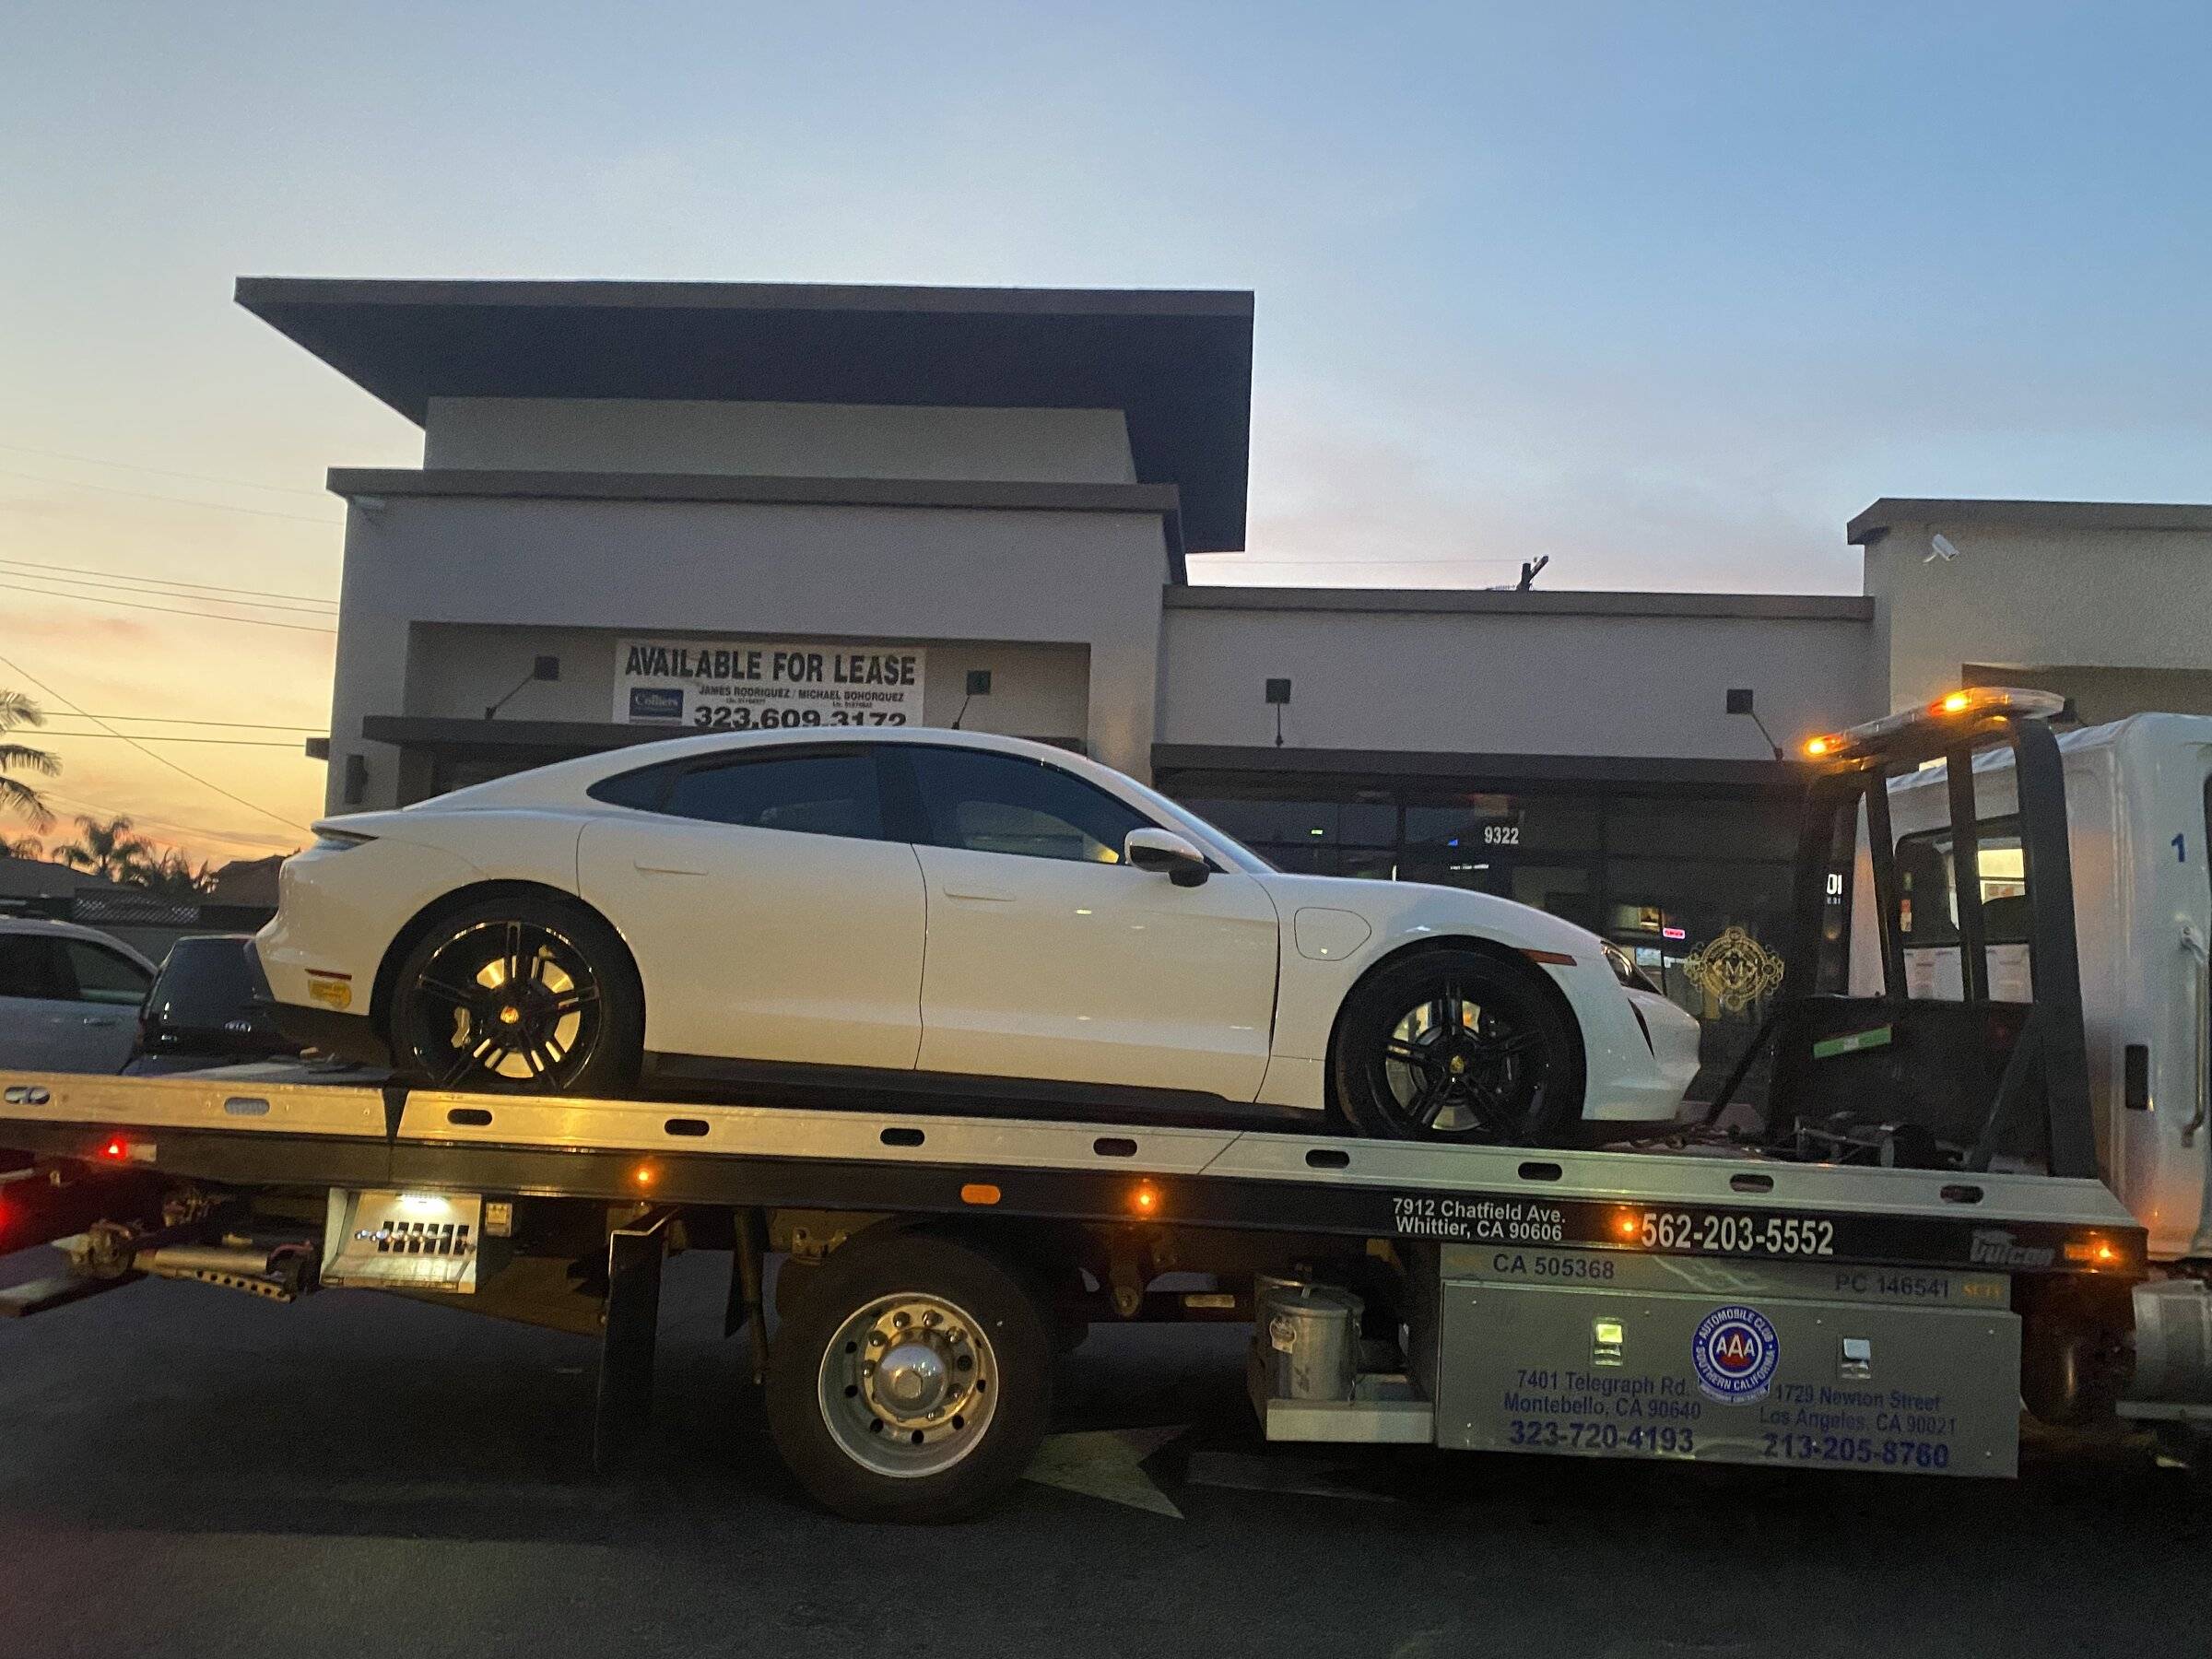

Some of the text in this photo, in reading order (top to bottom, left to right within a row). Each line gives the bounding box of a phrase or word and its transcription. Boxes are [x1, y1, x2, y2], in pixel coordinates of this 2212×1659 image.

[625, 646, 915, 686] AVAILABLE FOR LEASE
[699, 685, 731, 697] JAMES
[734, 687, 790, 700] RODRIGUEZ
[798, 689, 841, 701] MICHAEL
[1484, 826, 1520, 845] 9322
[2171, 833, 2185, 863] 1
[1393, 1197, 1566, 1224] 7912 Chatfield Ave.
[1395, 1216, 1563, 1241] Whittier, CA 90606
[1641, 1212, 1834, 1255] 562-203-5552
[1493, 1253, 1614, 1280] CA 505368
[1834, 1273, 1866, 1294] PC
[1877, 1277, 1948, 1298] 146541
[1699, 1309, 1774, 1343] AUTOMOBILE CLUB
[1716, 1334, 1756, 1359] AAA
[1696, 1347, 1775, 1391] SOUTHERN CALIFORNIA
[1517, 1370, 1558, 1390] 7401
[1566, 1371, 1653, 1396] Telegraph
[1503, 1392, 1701, 1420] Montebello, CA 90640
[1775, 1384, 1814, 1404] 1729
[1819, 1387, 1883, 1408] Newton
[1889, 1390, 1944, 1411] Street
[1759, 1406, 1790, 1425] Los
[1877, 1413, 1901, 1433] CA
[1906, 1417, 1957, 1435] 90021
[1509, 1419, 1695, 1453] 323-720-4193
